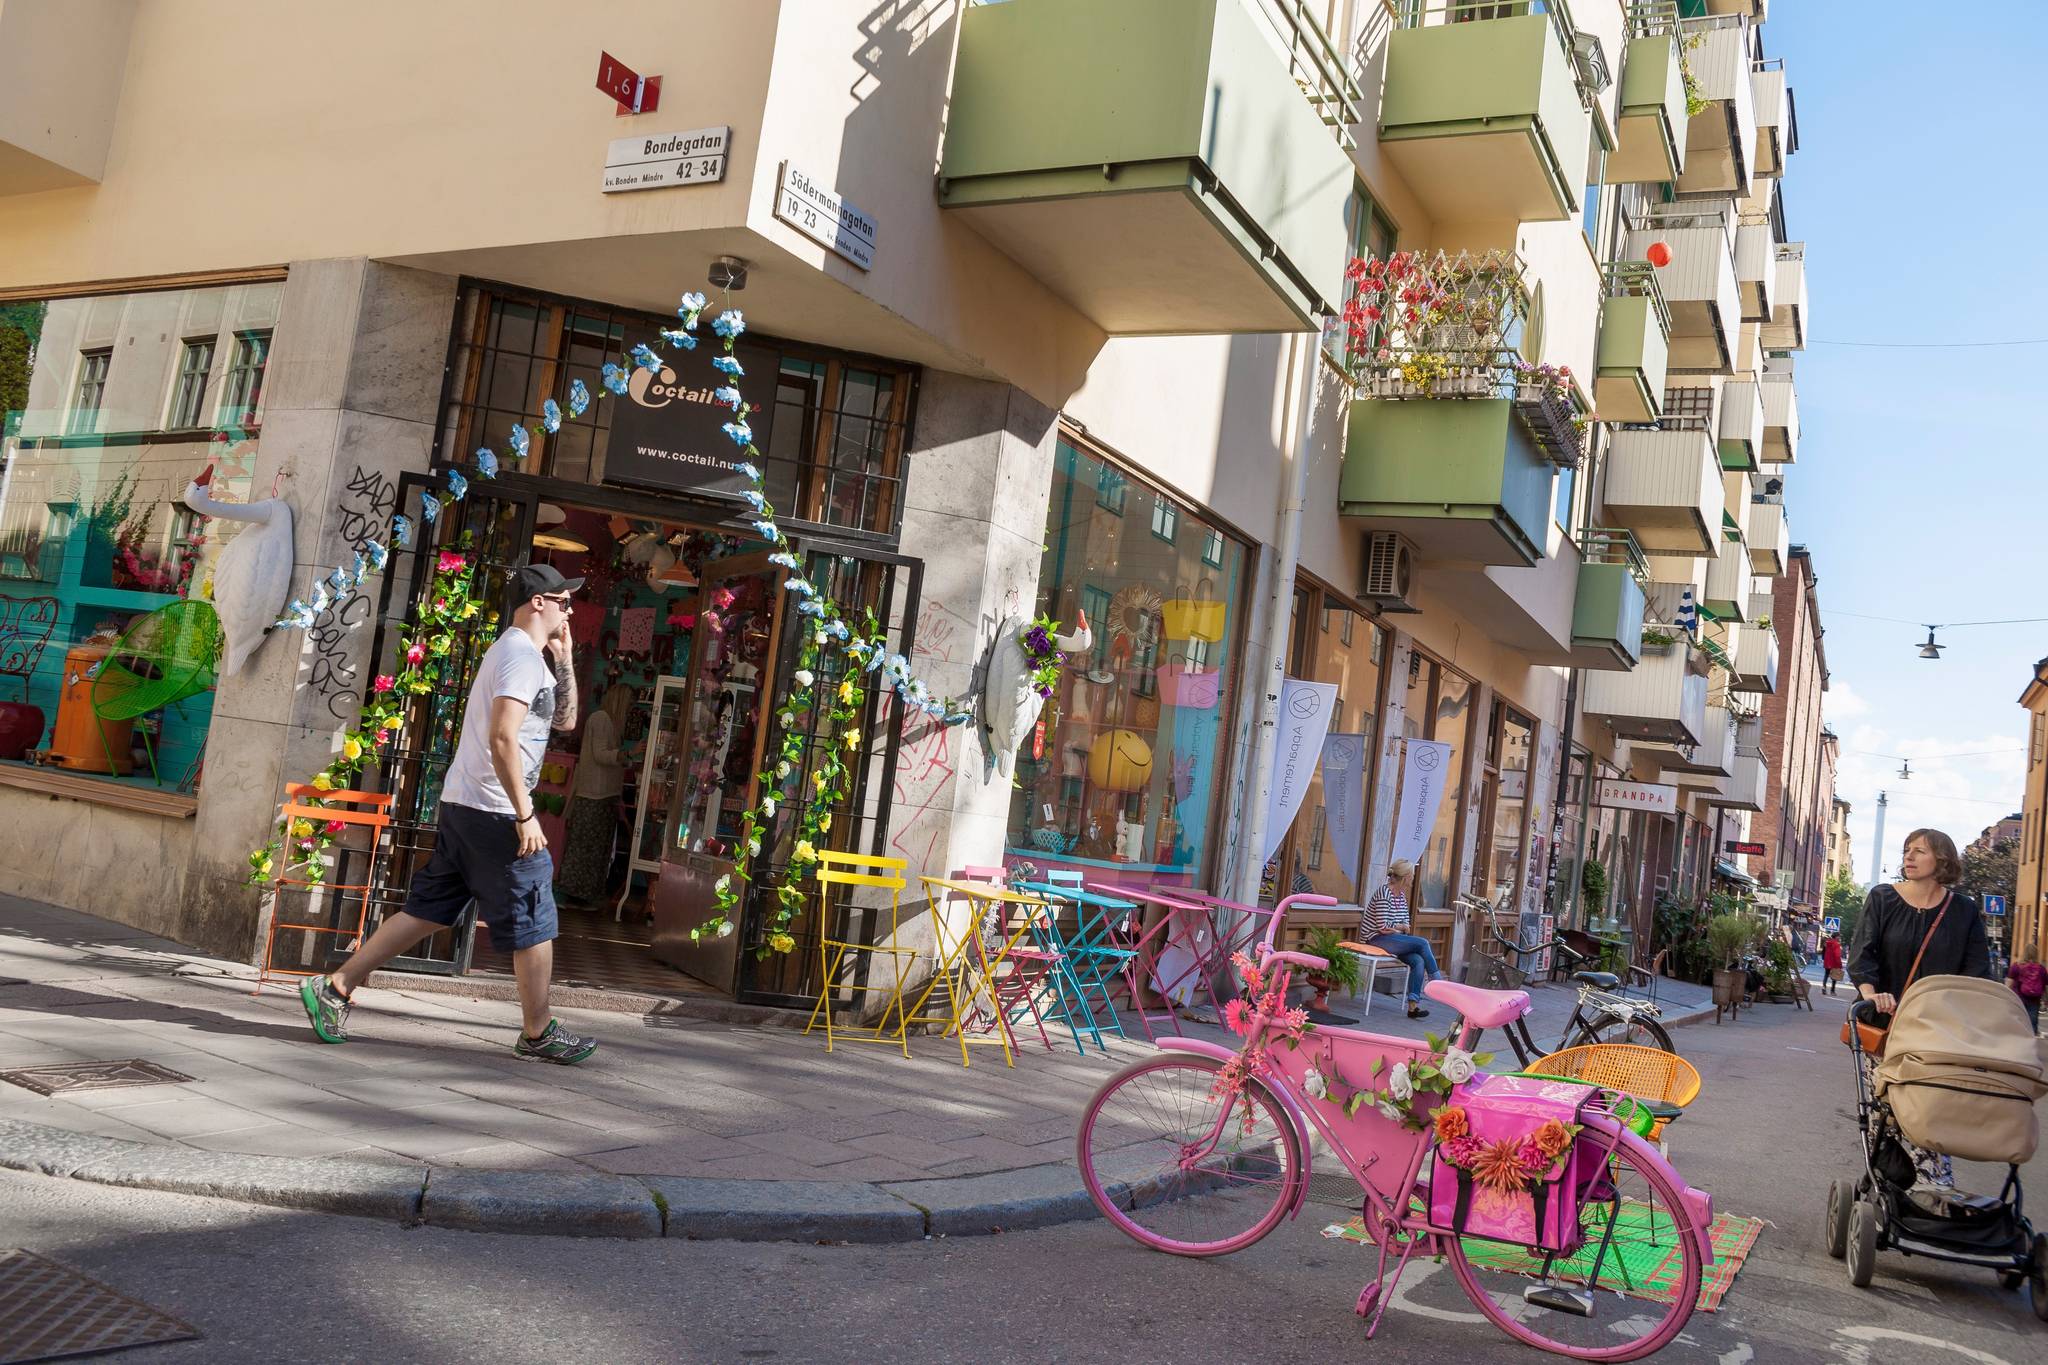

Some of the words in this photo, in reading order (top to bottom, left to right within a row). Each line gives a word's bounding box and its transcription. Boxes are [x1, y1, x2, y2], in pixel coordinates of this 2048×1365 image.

[644, 135, 722, 155] Bondegatan
[615, 175, 638, 185] Bonden
[642, 172, 664, 183] Mindre
[791, 170, 874, 238] Södermannagatan
[835, 235, 852, 252] Bonden
[853, 247, 869, 263] Mindre
[628, 364, 715, 408] Coctail
[637, 446, 736, 470] www.coctail.nu
[1604, 788, 1664, 803] GRANDPA
